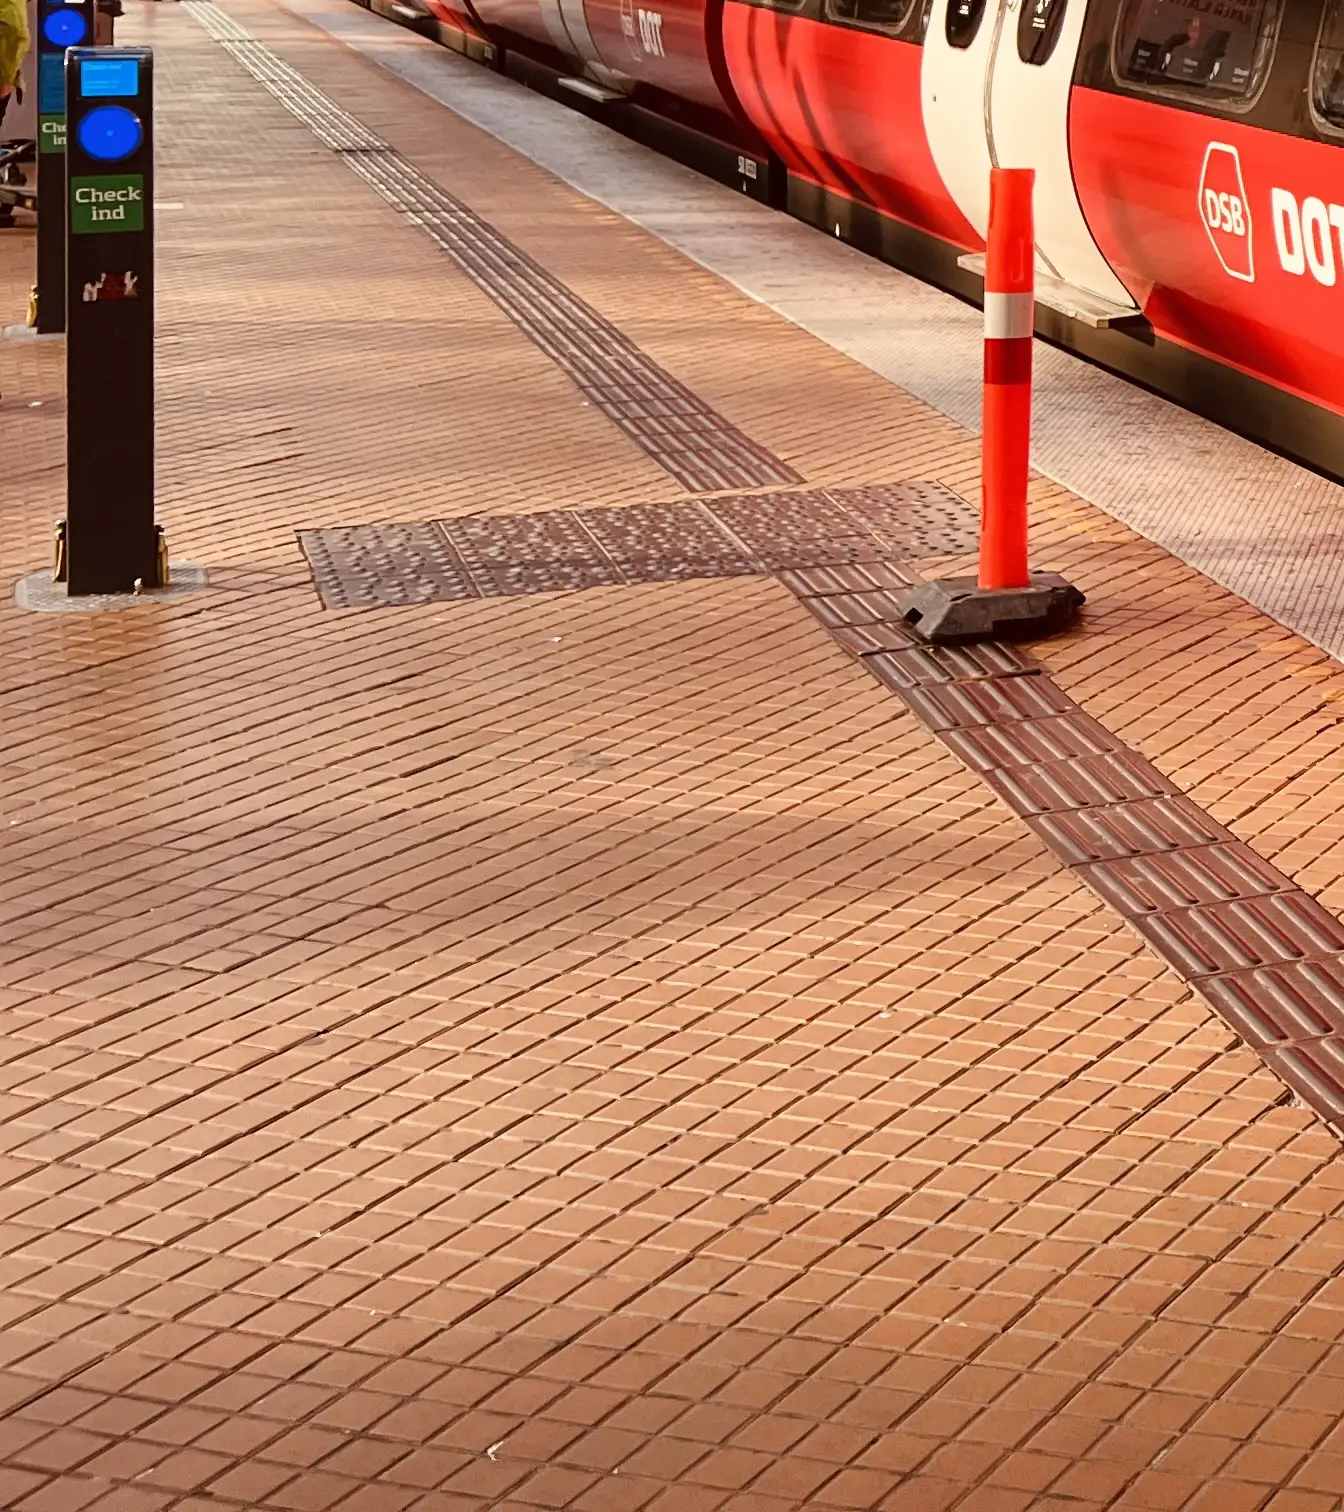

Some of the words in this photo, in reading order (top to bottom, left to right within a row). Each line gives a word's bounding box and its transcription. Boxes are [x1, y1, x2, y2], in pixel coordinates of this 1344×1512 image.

[41, 121, 66, 133] Che
[75, 186, 142, 204] Check
[91, 205, 125, 221] ind
[1204, 188, 1246, 237] DSB
